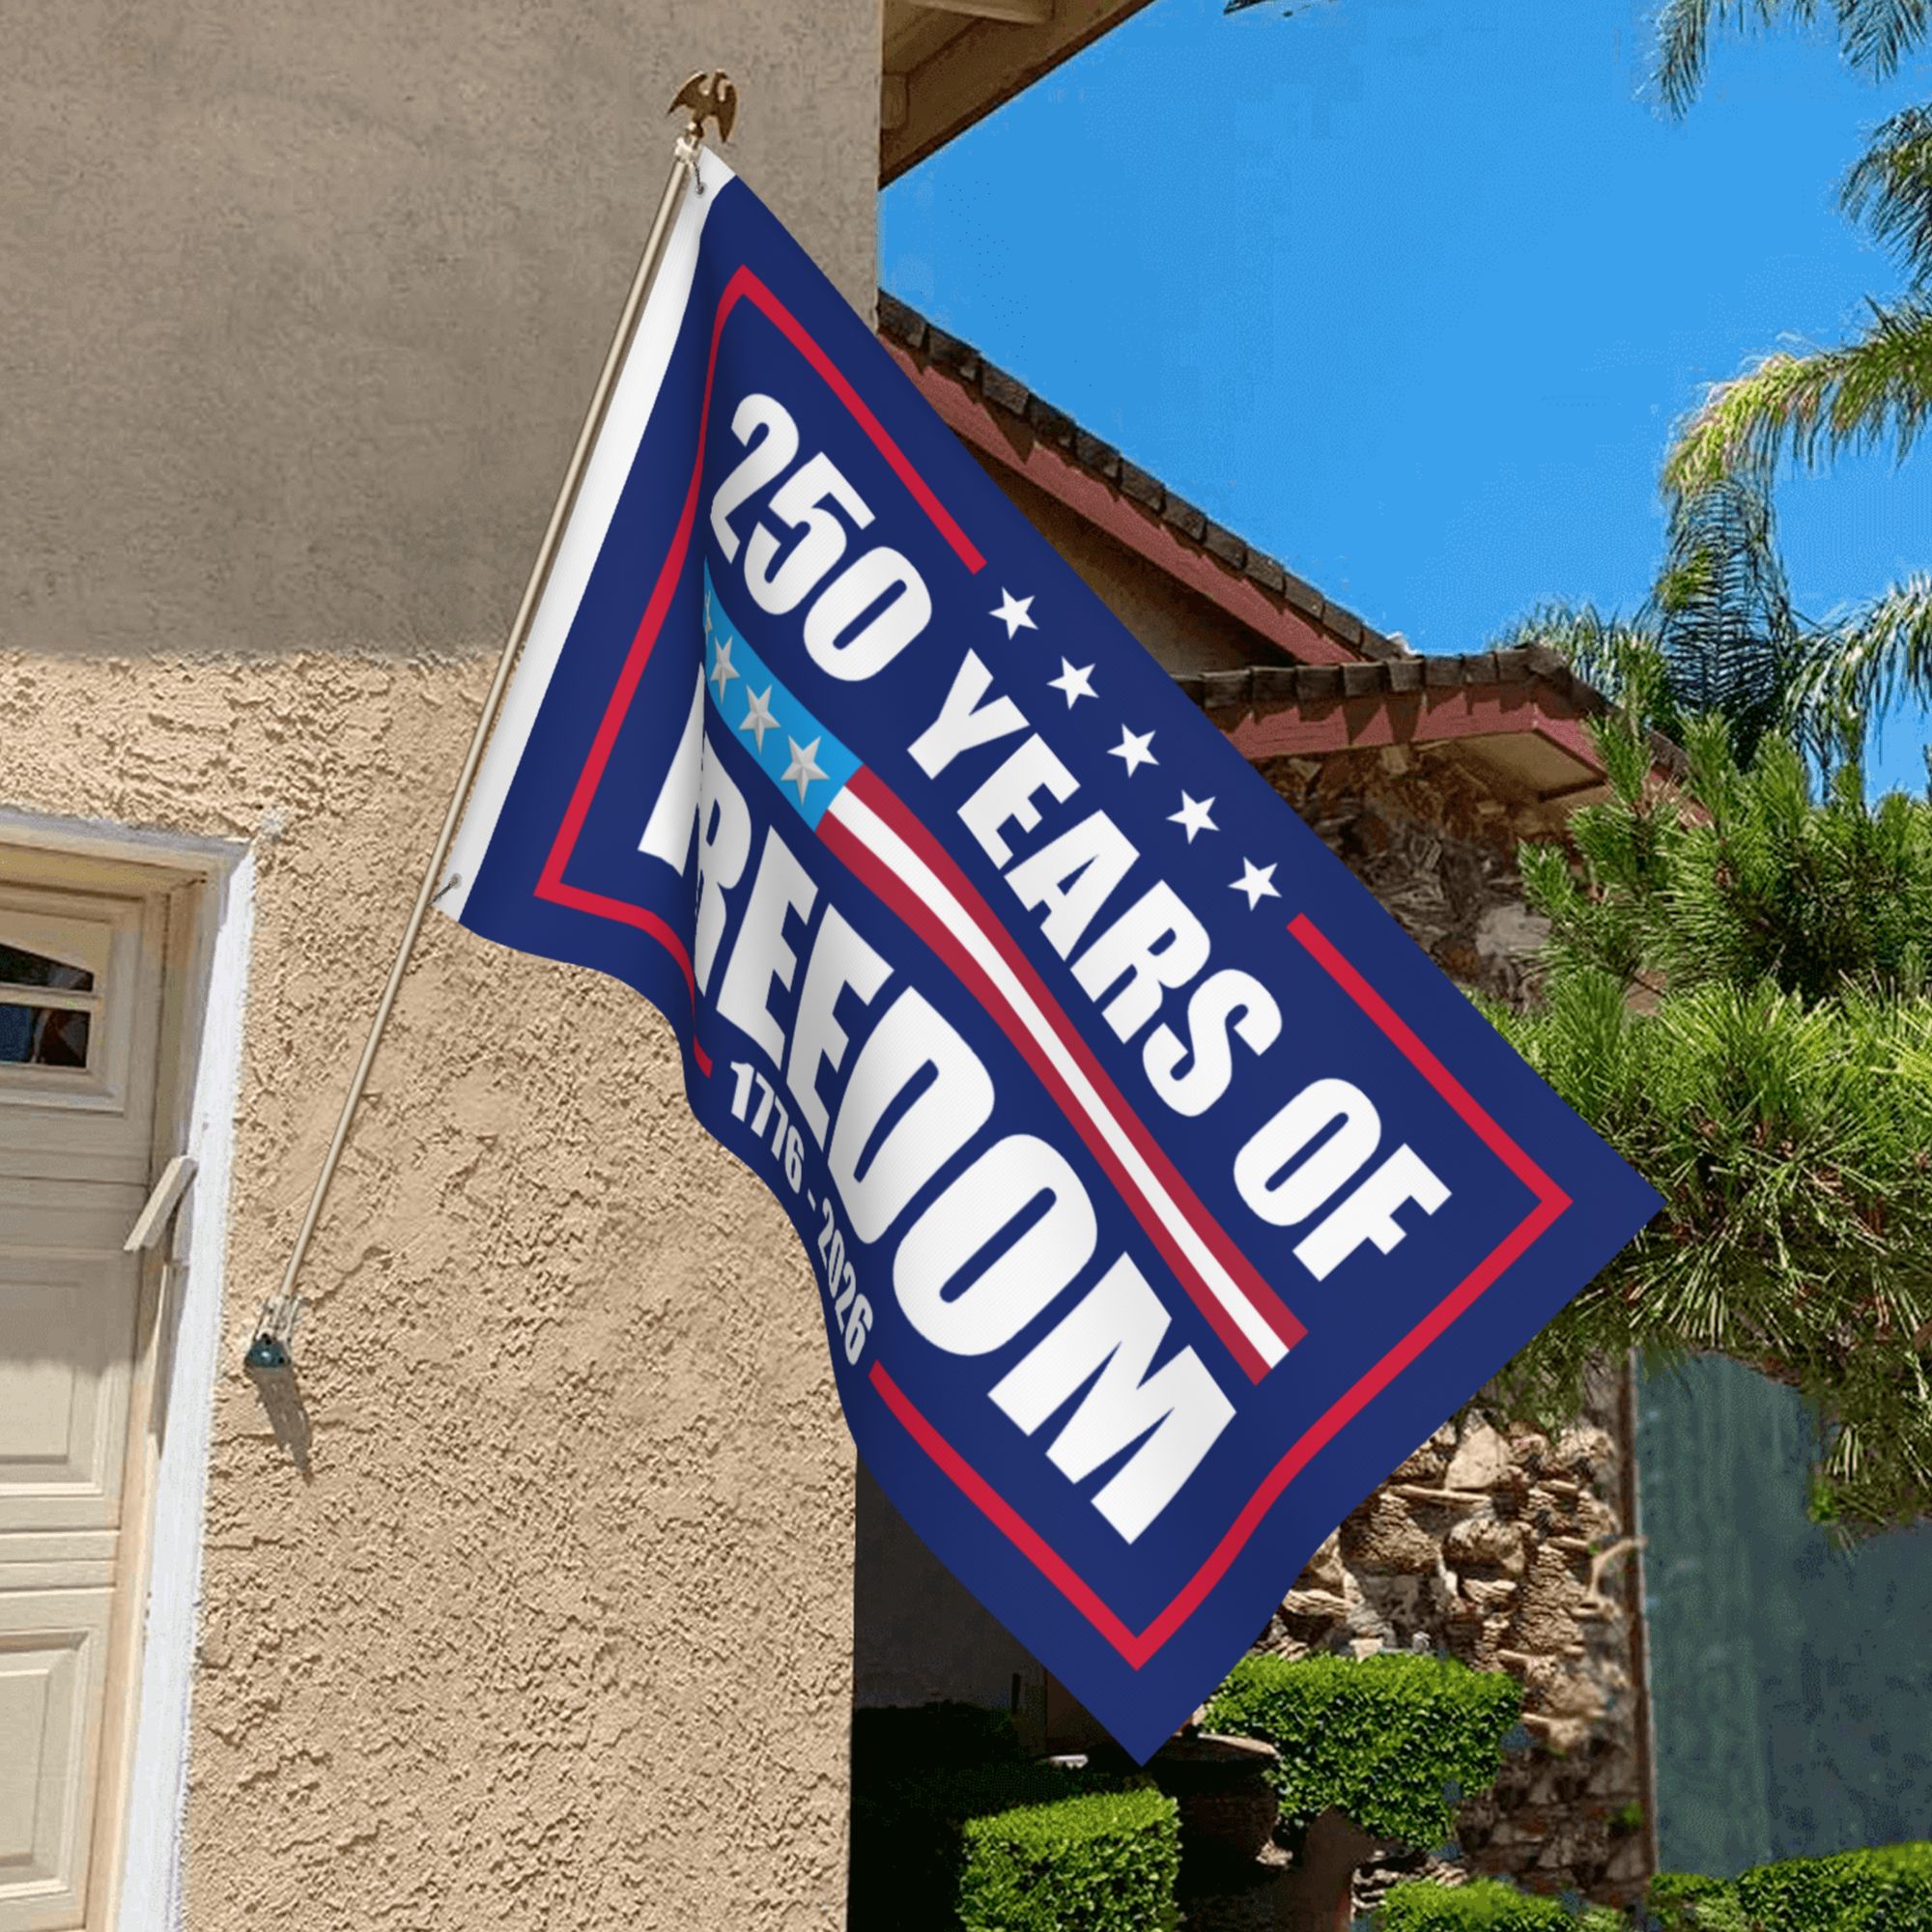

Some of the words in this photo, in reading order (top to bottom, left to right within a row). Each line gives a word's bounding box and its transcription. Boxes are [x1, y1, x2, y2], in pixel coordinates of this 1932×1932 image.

[711, 394, 932, 682] 250
[907, 649, 1283, 1118] YEARS
[1233, 1078, 1453, 1282] OF
